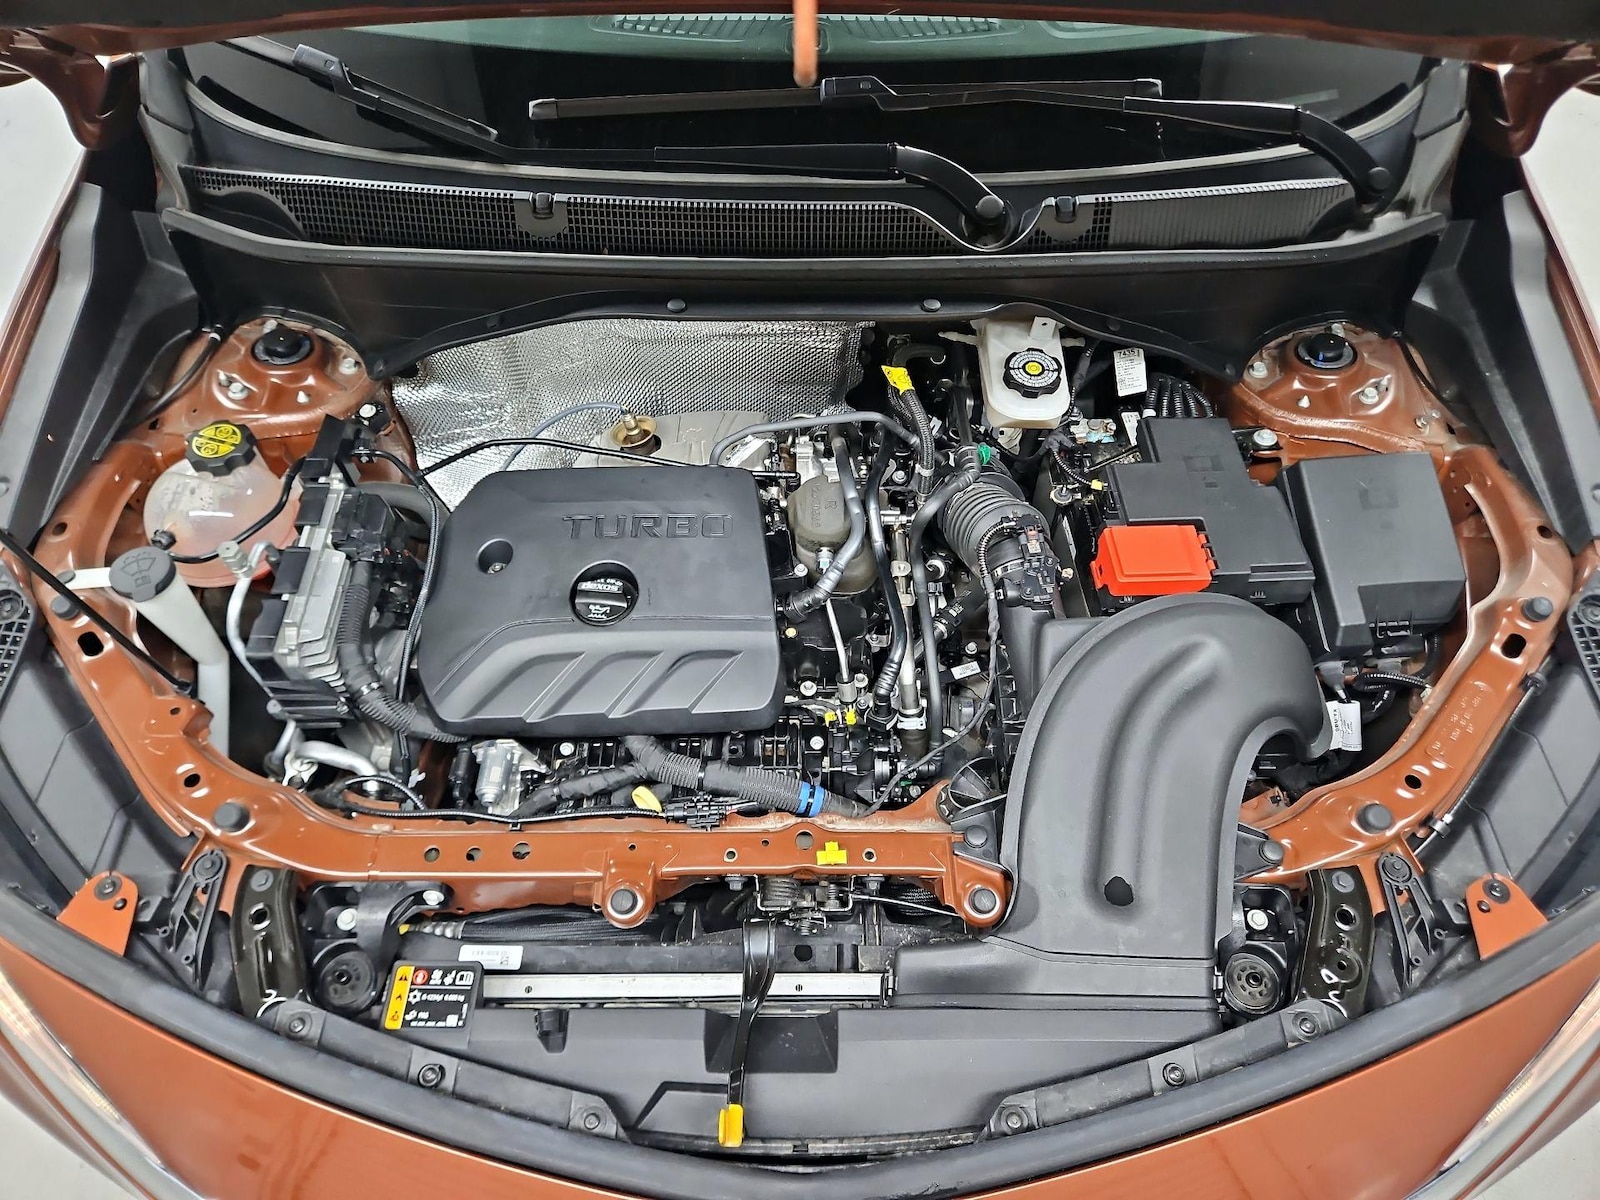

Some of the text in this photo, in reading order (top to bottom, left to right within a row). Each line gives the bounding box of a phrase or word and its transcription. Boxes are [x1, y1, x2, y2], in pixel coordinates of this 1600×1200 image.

[1117, 349, 1136, 357] 7435
[562, 513, 733, 539] TURBO
[581, 581, 619, 592] dexos
